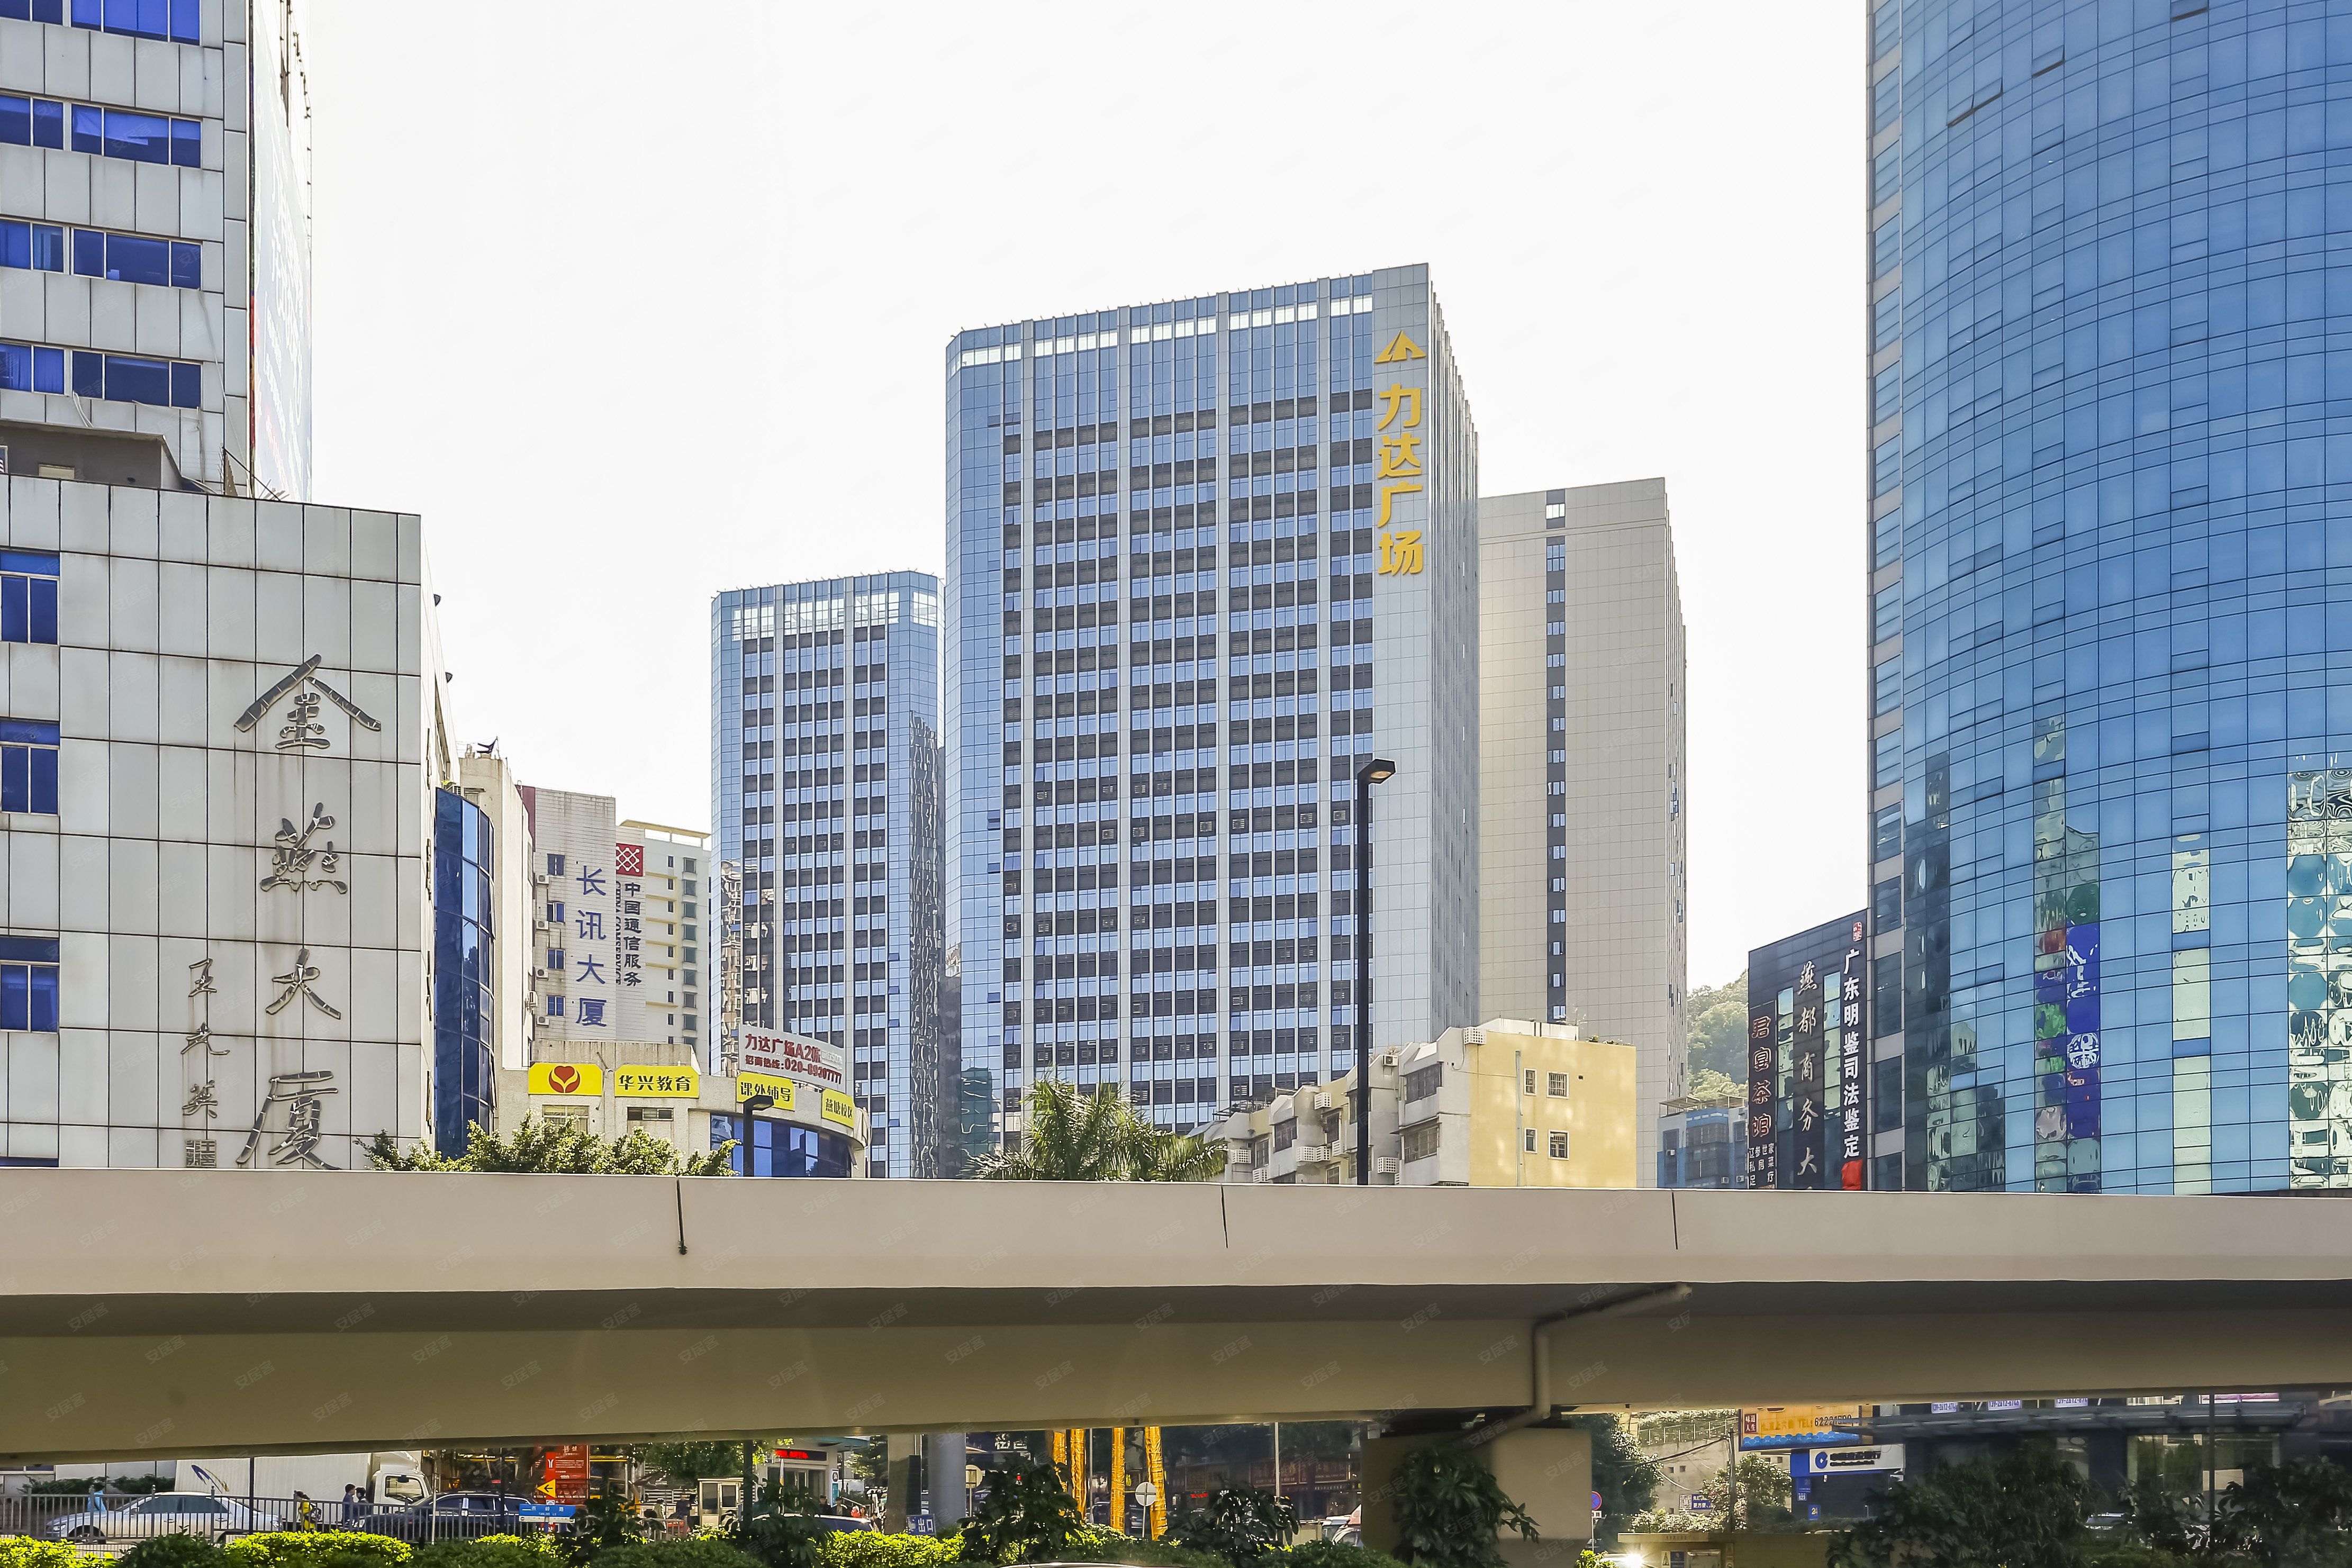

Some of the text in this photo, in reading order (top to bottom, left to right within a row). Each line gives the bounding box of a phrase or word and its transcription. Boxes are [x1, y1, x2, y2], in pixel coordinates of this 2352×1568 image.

[1377, 384, 1423, 576] 力达广场
[575, 865, 608, 1027] 长讯大厦
[623, 882, 641, 986] 中国通信服务
[745, 1034, 821, 1064] 力达广场A2栋
[1751, 1015, 1772, 1138] 君宴茶馆
[1797, 960, 1819, 1190] 燕都商务大
[1843, 948, 1860, 1159] 广东明鉴司法鉴定
[618, 1075, 691, 1092] 华兴教育
[740, 1082, 791, 1102] 课外辅导
[826, 1098, 853, 1118] 燕塘校区
[1749, 1156, 1774, 1172] 私房菜
[1750, 1171, 1774, 1185] 足疗
